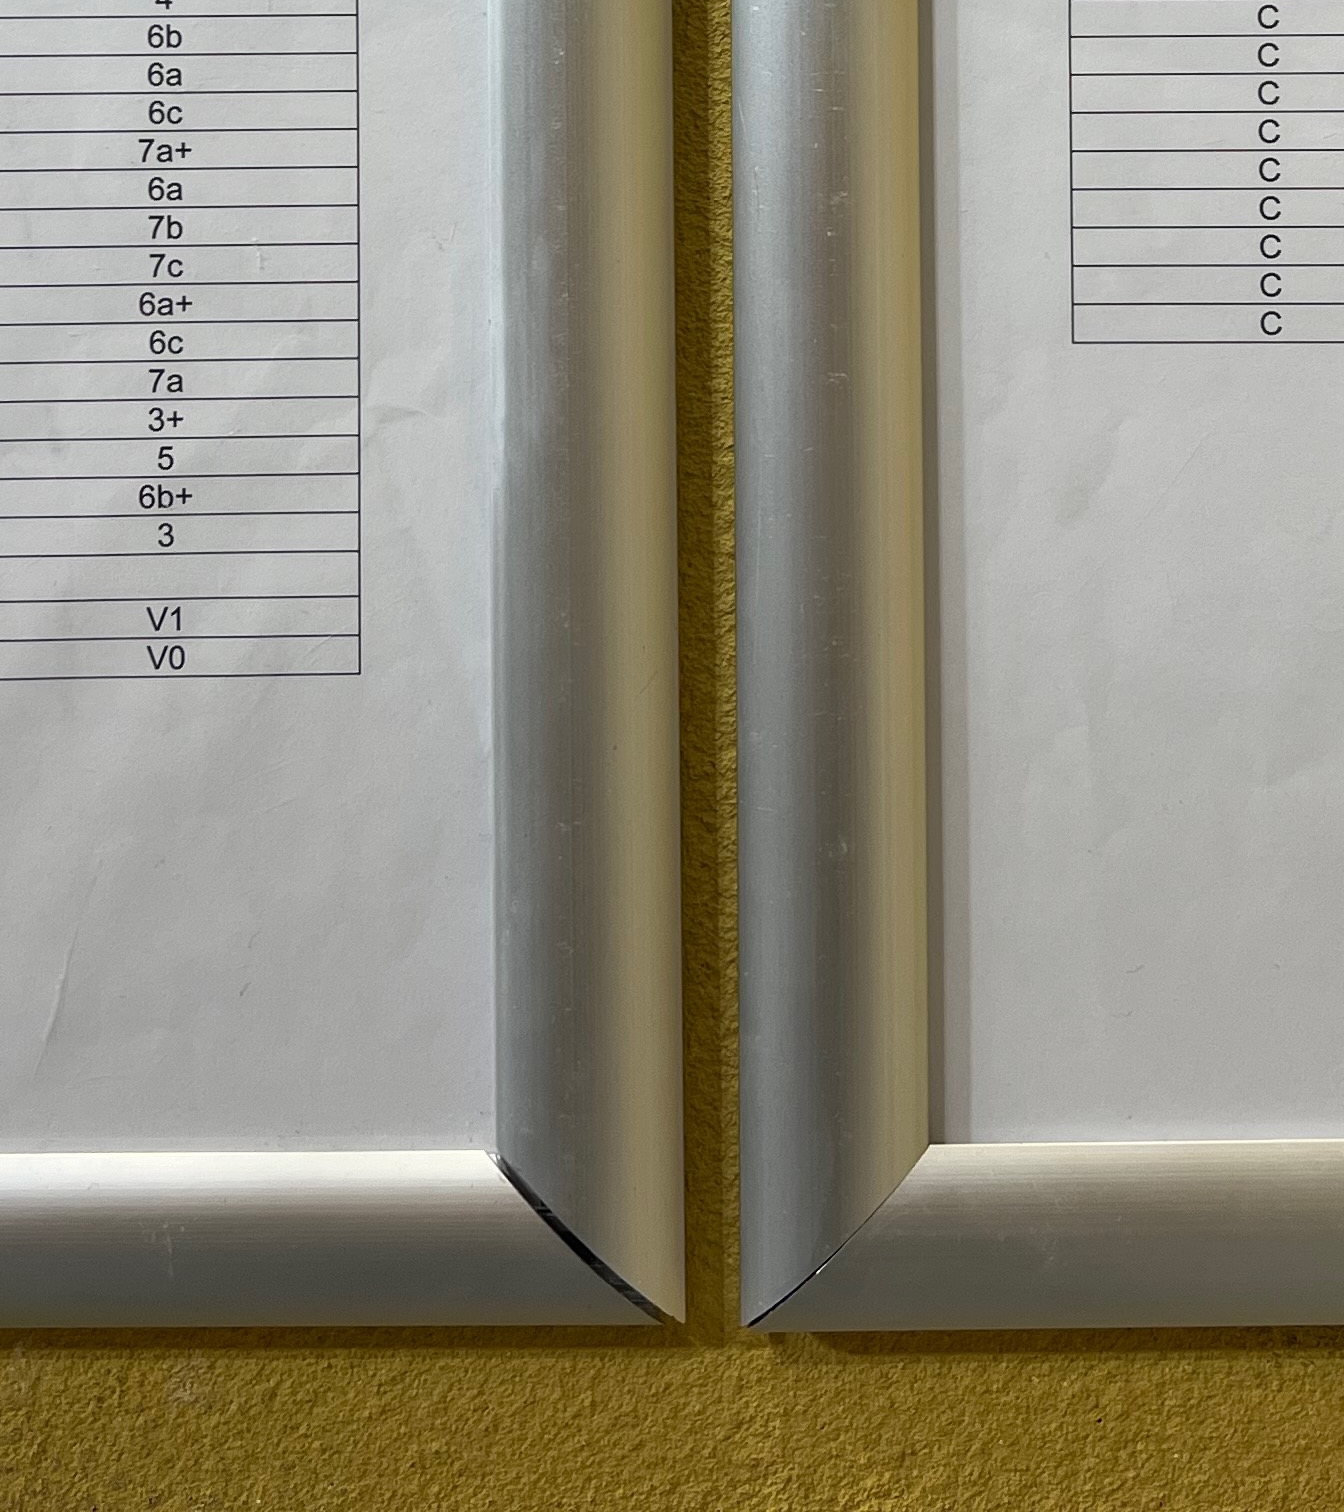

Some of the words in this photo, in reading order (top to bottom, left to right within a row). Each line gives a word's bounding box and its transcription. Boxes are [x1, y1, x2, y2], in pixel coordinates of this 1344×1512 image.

[147, 23, 183, 49] 6b
[1258, 118, 1281, 144] C
[148, 176, 183, 202] 6a
[1259, 195, 1282, 221] C
[1260, 310, 1283, 336] C
[148, 407, 184, 433] 3+
[146, 606, 181, 632] V1
[146, 645, 186, 670] V0
